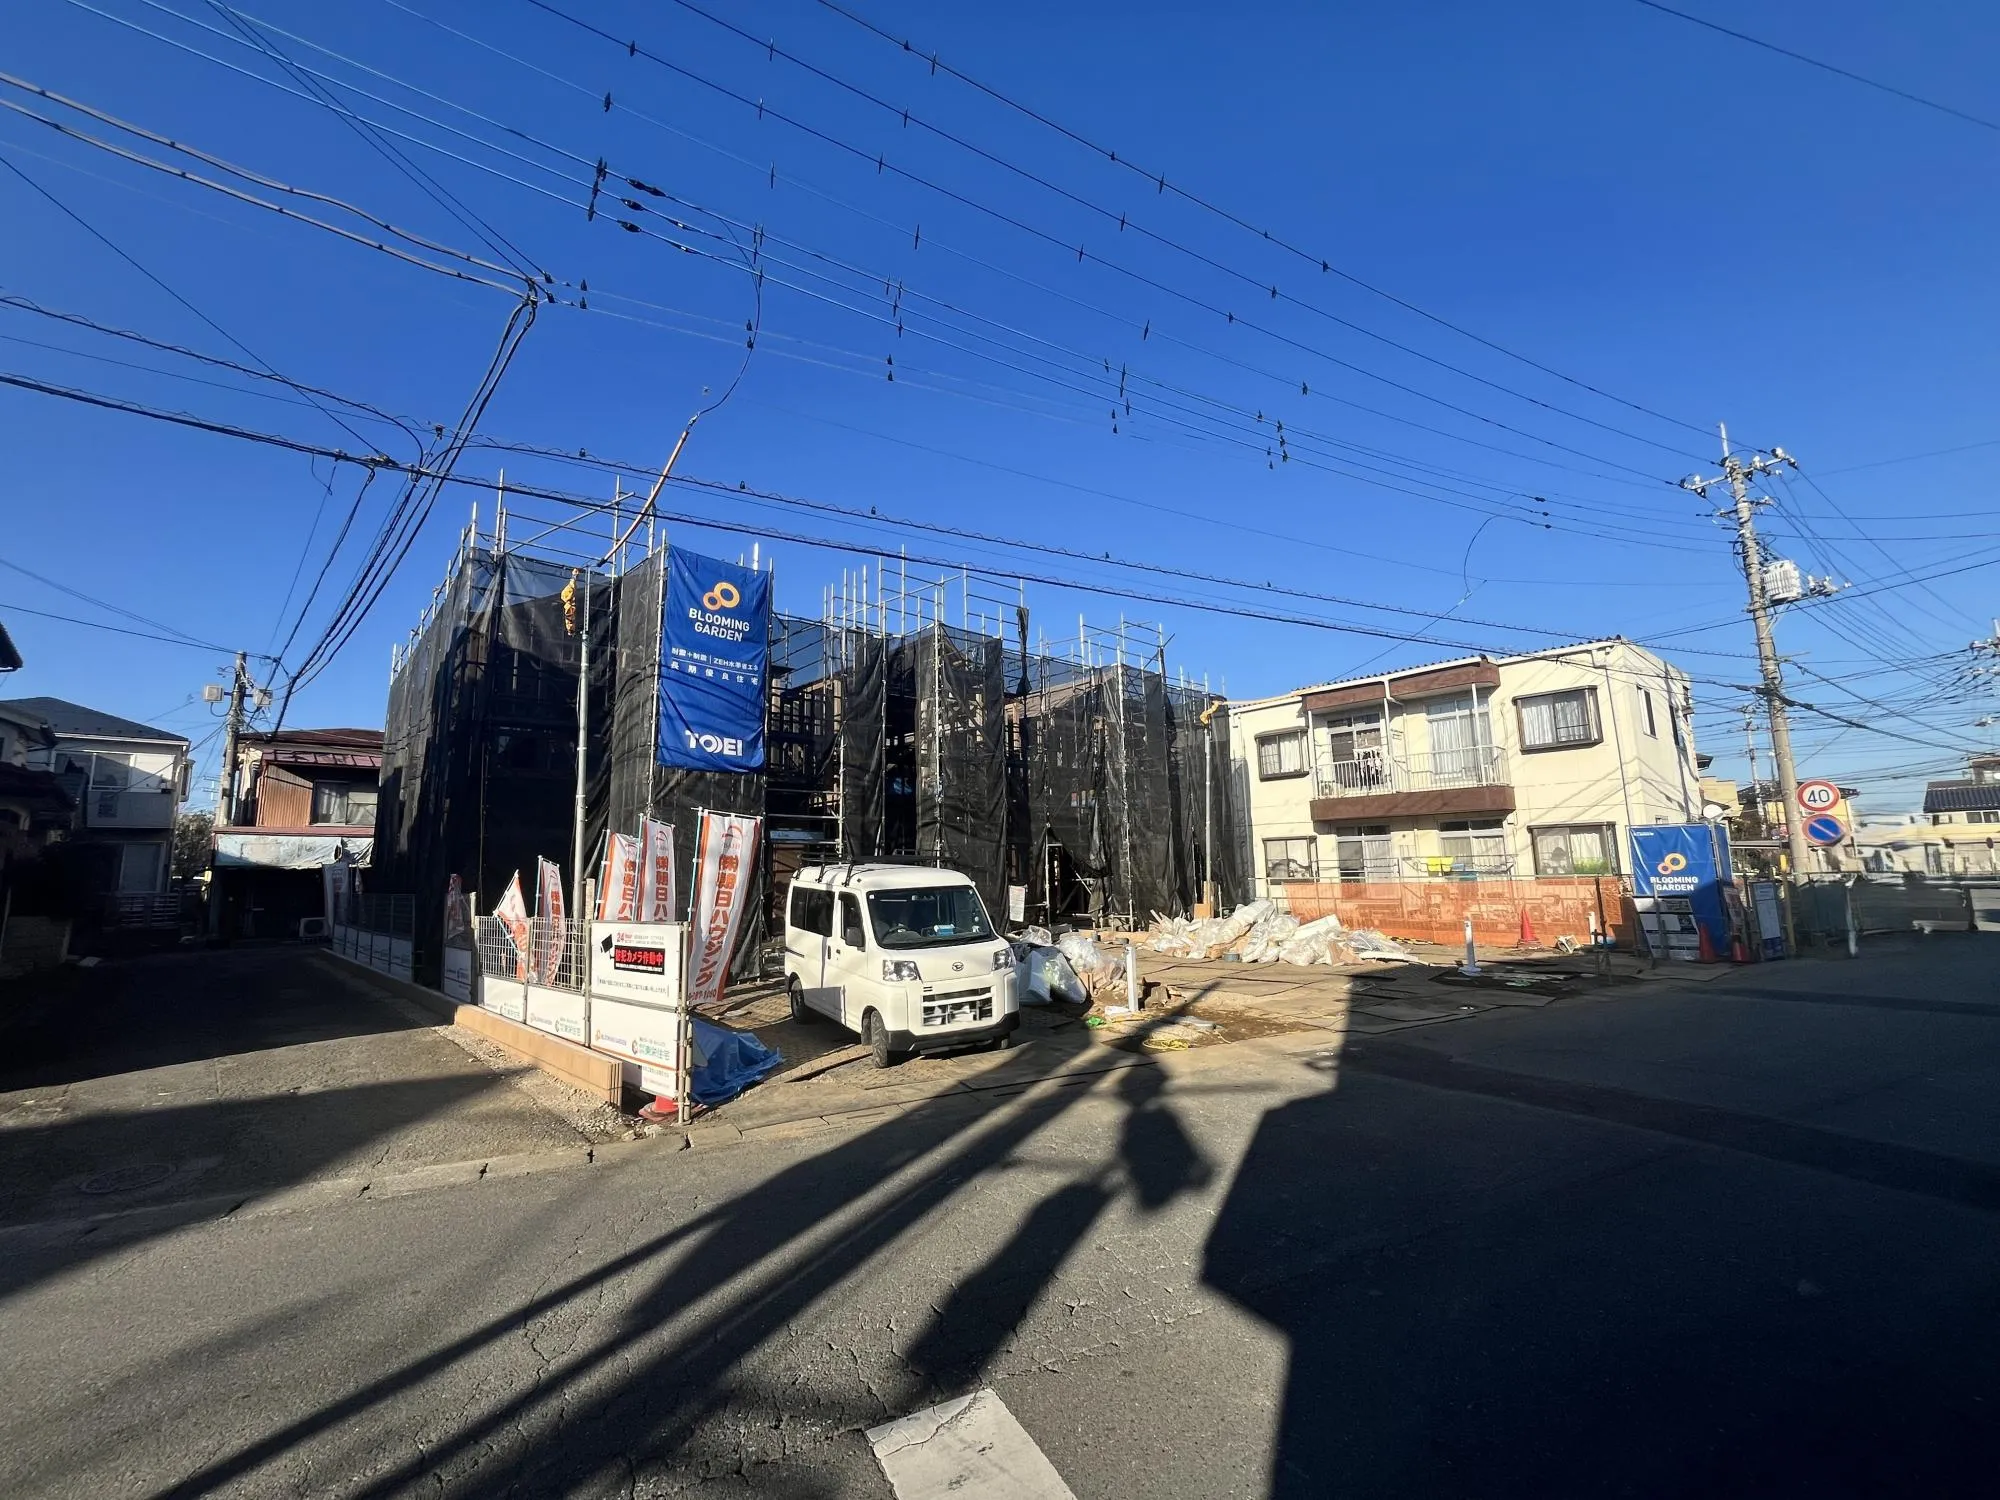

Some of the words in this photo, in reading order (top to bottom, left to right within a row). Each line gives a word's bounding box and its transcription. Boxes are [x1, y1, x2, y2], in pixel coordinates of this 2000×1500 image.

[689, 607, 750, 632] BLOOMING
[694, 621, 743, 642] GARDEN
[684, 729, 743, 757] TOEI
[1807, 789, 1830, 804] 40
[1650, 876, 1699, 884] BLOOMING
[1656, 883, 1694, 891] GARDEN
[615, 949, 664, 966] 防犯カメラ作動中
